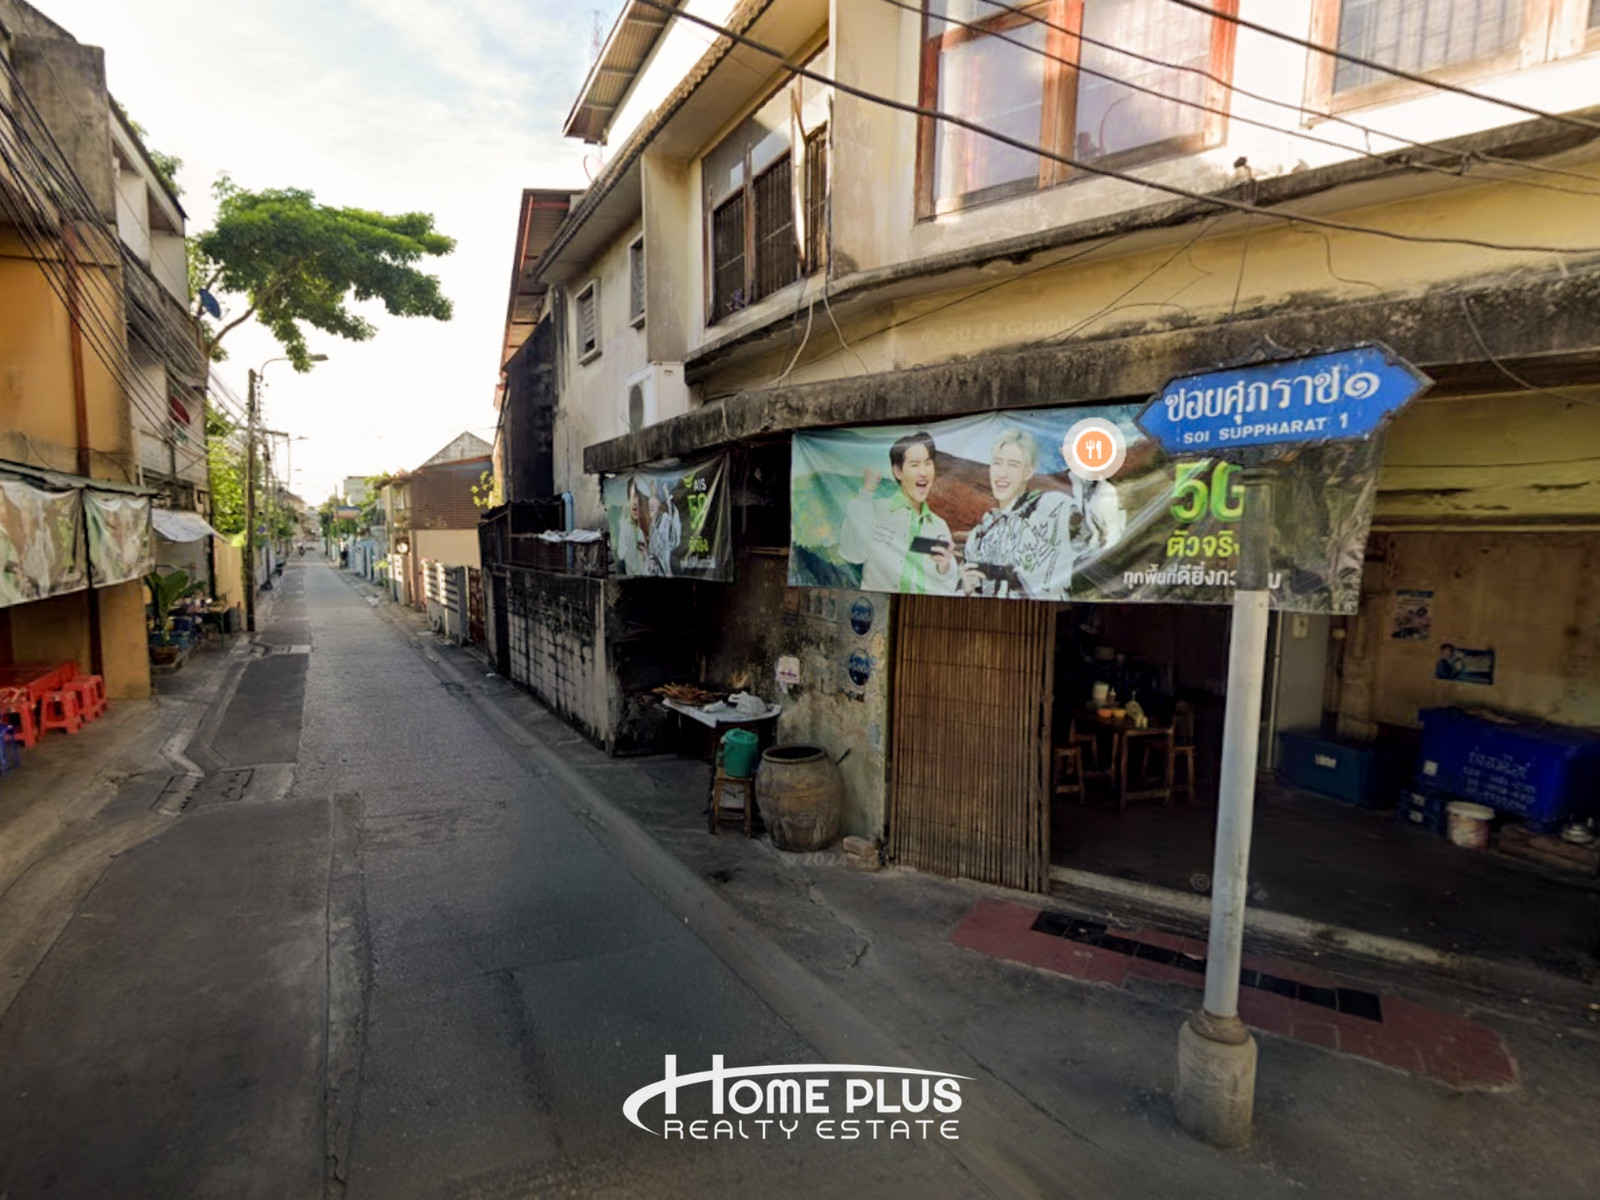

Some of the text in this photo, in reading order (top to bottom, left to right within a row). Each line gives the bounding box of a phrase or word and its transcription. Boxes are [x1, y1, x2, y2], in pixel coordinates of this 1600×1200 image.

[1183, 412, 1349, 444] SOI SUPPHARAT 1
[693, 478, 707, 491] AIS
[1166, 529, 1240, 558] ตัวจริ
